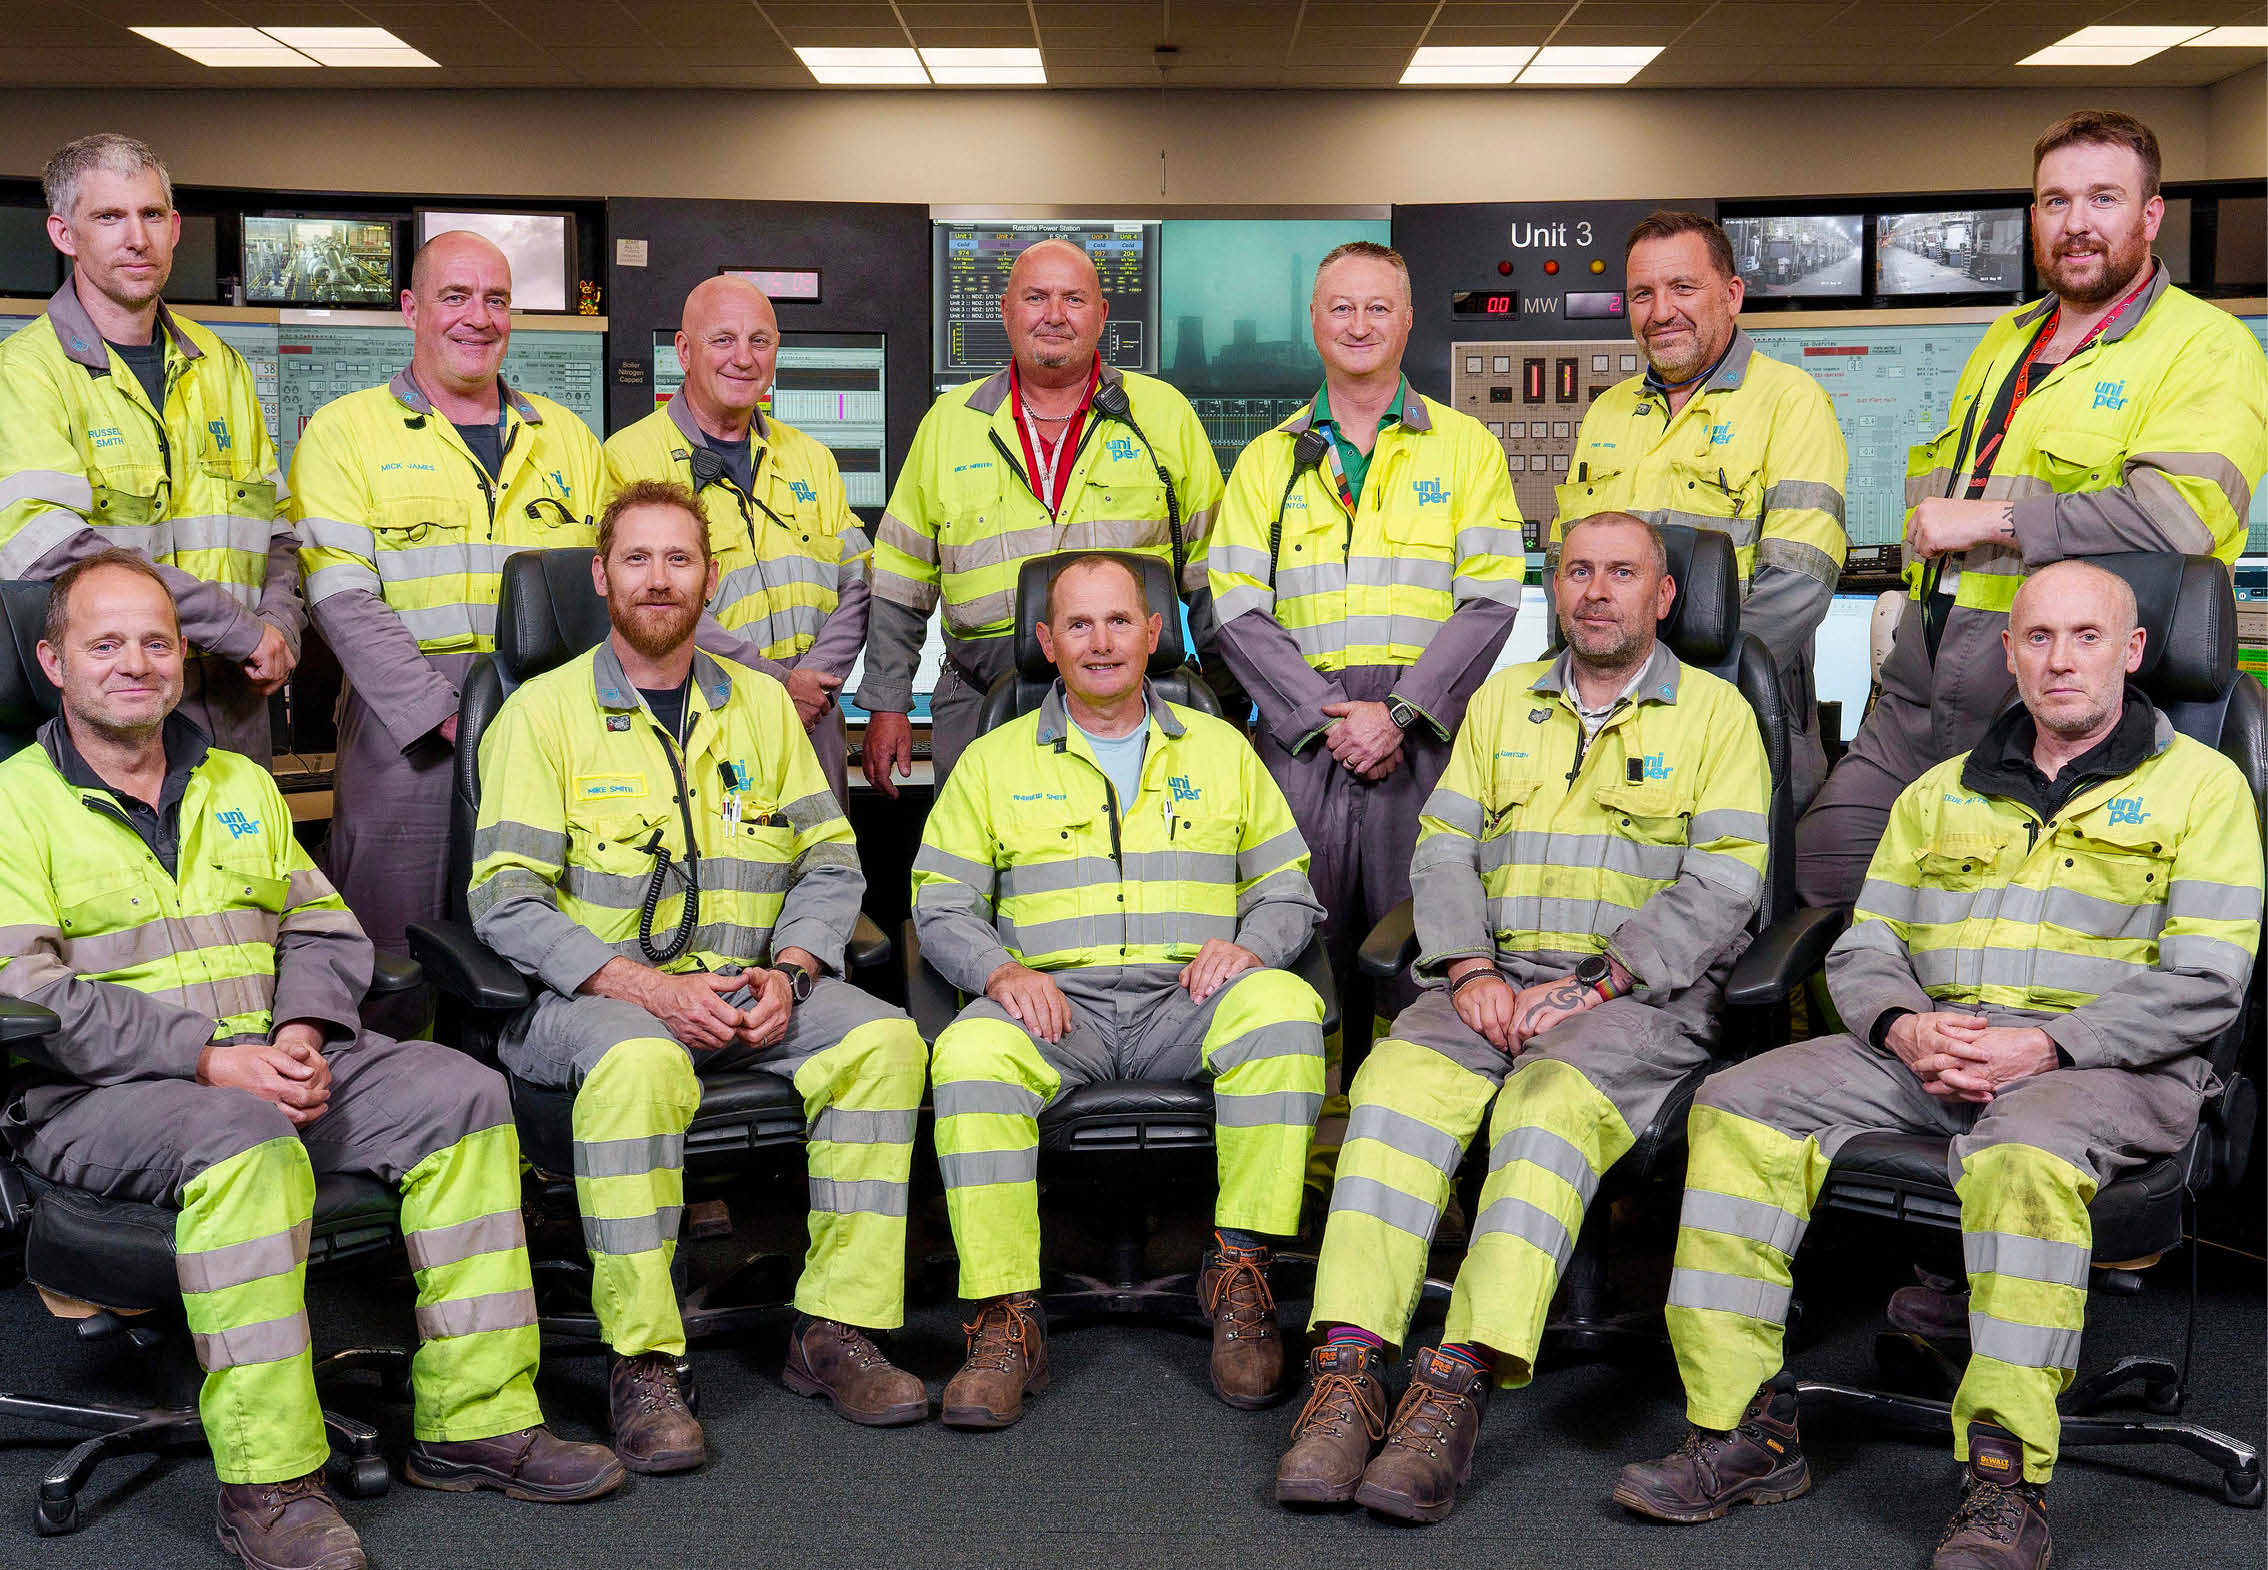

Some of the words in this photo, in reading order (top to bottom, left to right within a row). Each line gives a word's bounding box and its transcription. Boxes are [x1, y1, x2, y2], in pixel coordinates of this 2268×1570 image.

[1012, 224, 1038, 232] Ratcliffe
[1511, 223, 1567, 248] Unit
[1576, 221, 1593, 246] 3
[1524, 298, 1558, 313] MW
[264, 365, 276, 374] 58
[620, 376, 643, 384] Capped
[2094, 379, 2126, 397] uni
[264, 405, 276, 414] 68
[2092, 394, 2129, 411] per
[208, 415, 227, 435] uni
[1105, 436, 1131, 450] uni
[1112, 449, 1141, 462] per
[381, 463, 403, 472] MICK
[407, 463, 435, 471] JAMES
[789, 479, 809, 493] uni
[1412, 477, 1440, 492] uni
[795, 491, 817, 504] per
[1418, 491, 1451, 507] per
[1643, 751, 1664, 768] ni
[1168, 775, 1191, 790] uni
[1173, 787, 1202, 802] per
[2107, 796, 2143, 813] uni
[216, 807, 245, 826] uni
[2107, 810, 2151, 827] per
[229, 818, 261, 840] per
